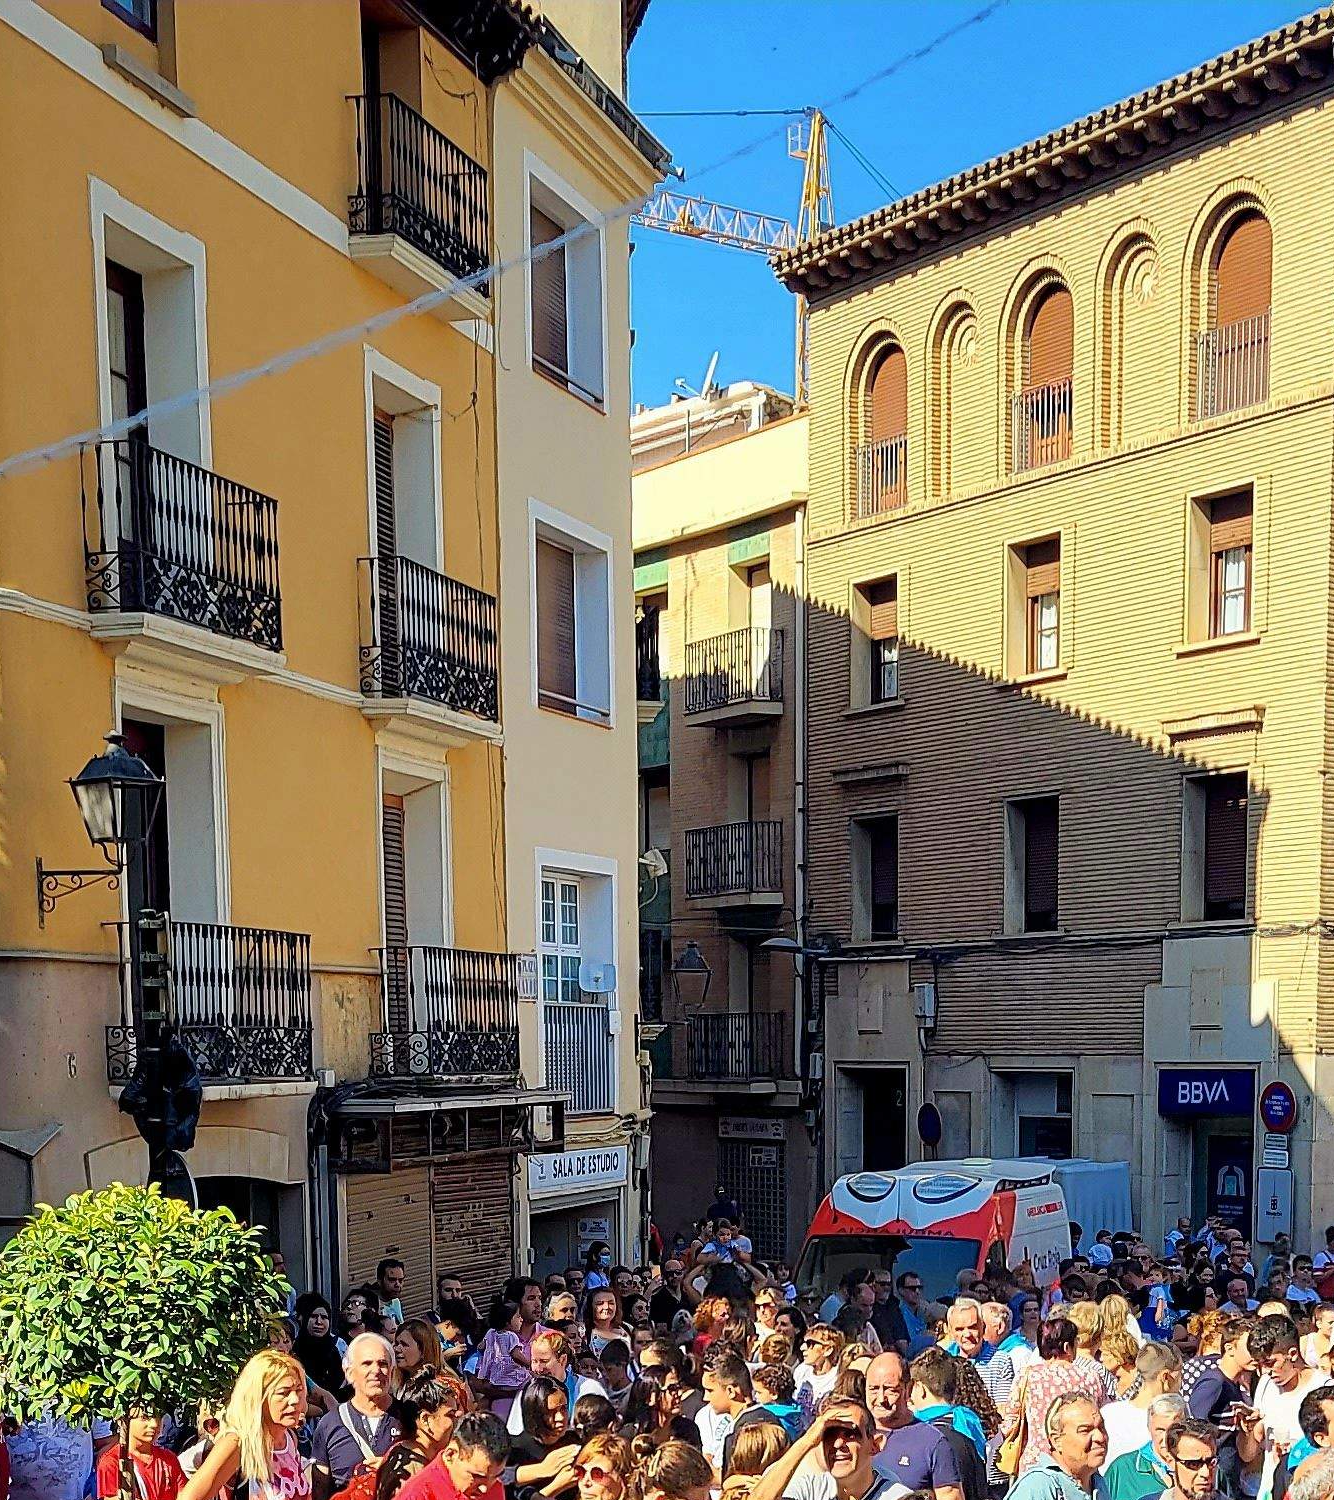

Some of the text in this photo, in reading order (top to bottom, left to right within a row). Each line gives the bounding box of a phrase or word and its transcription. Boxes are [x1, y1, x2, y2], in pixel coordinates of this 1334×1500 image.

[1178, 1079, 1229, 1104] BBVA
[553, 1152, 619, 1178] SALA DE ESTUDIO
